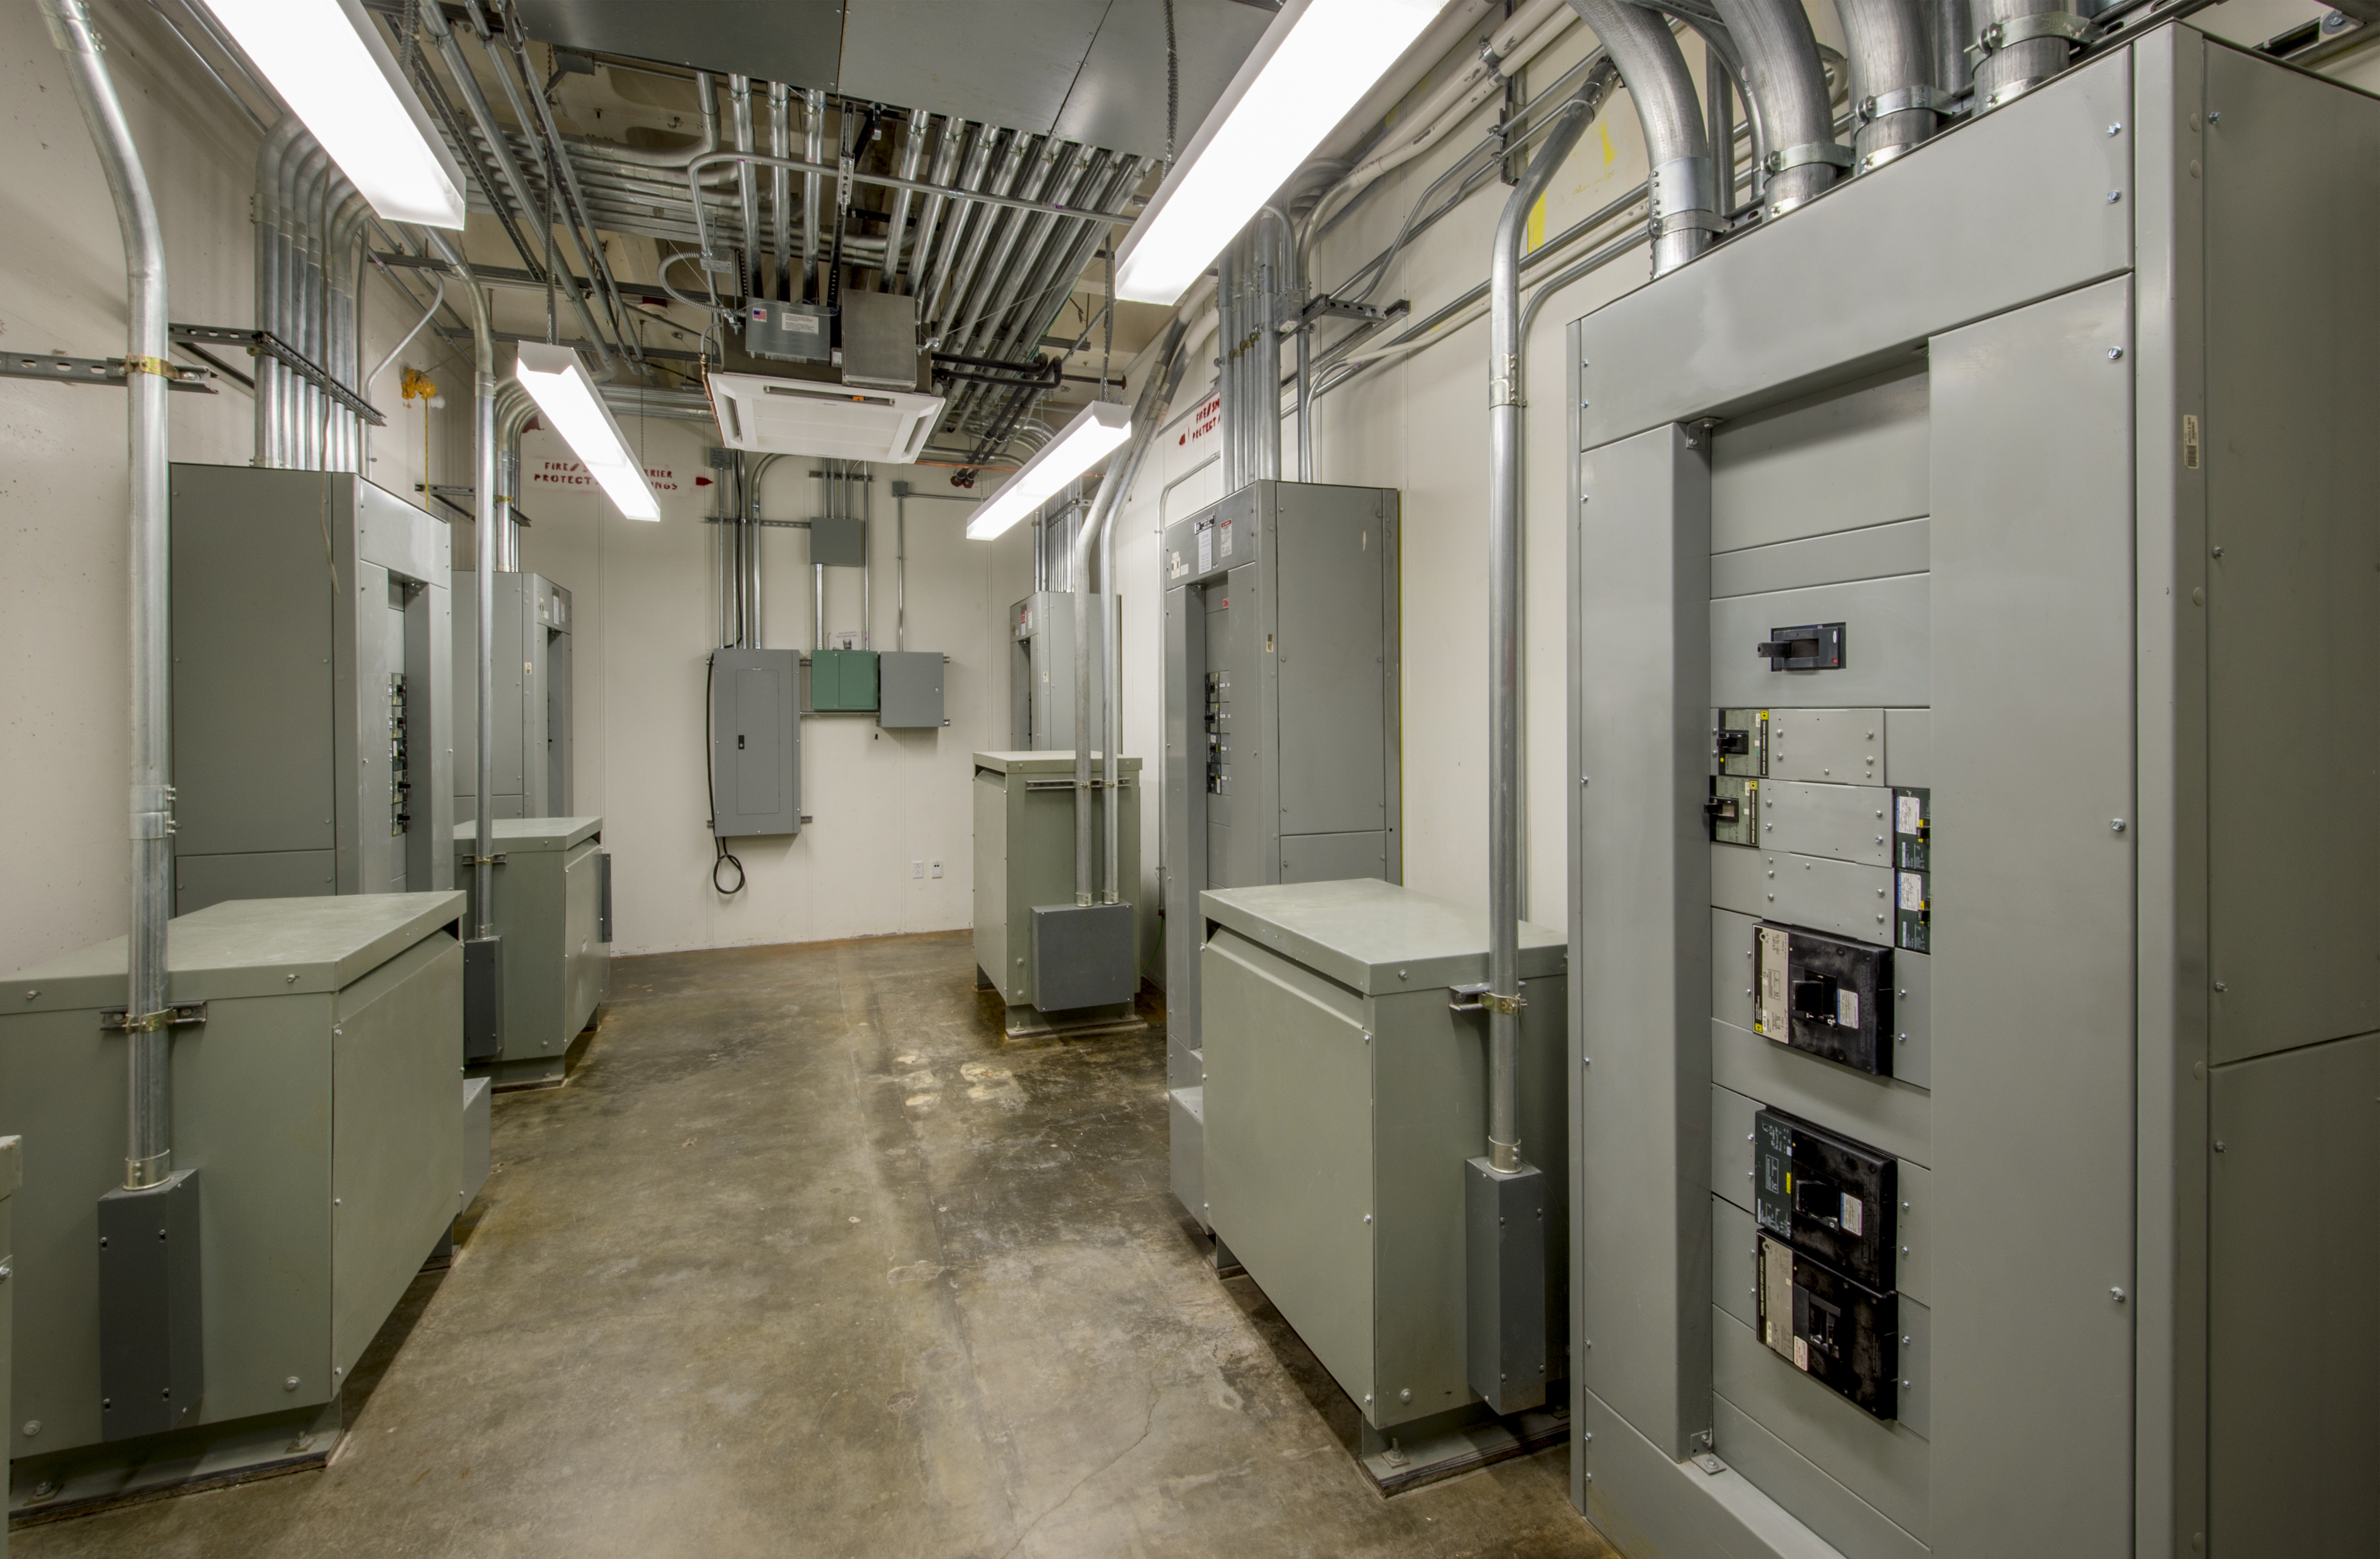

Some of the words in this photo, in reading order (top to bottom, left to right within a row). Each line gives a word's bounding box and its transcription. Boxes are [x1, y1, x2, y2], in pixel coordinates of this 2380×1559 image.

[1196, 398, 1220, 424] FIRE/SM
[1193, 416, 1217, 442] PROTECT
[534, 474, 592, 485] PROTECT
[650, 481, 678, 490] INGS
[643, 469, 672, 479] RRIER
